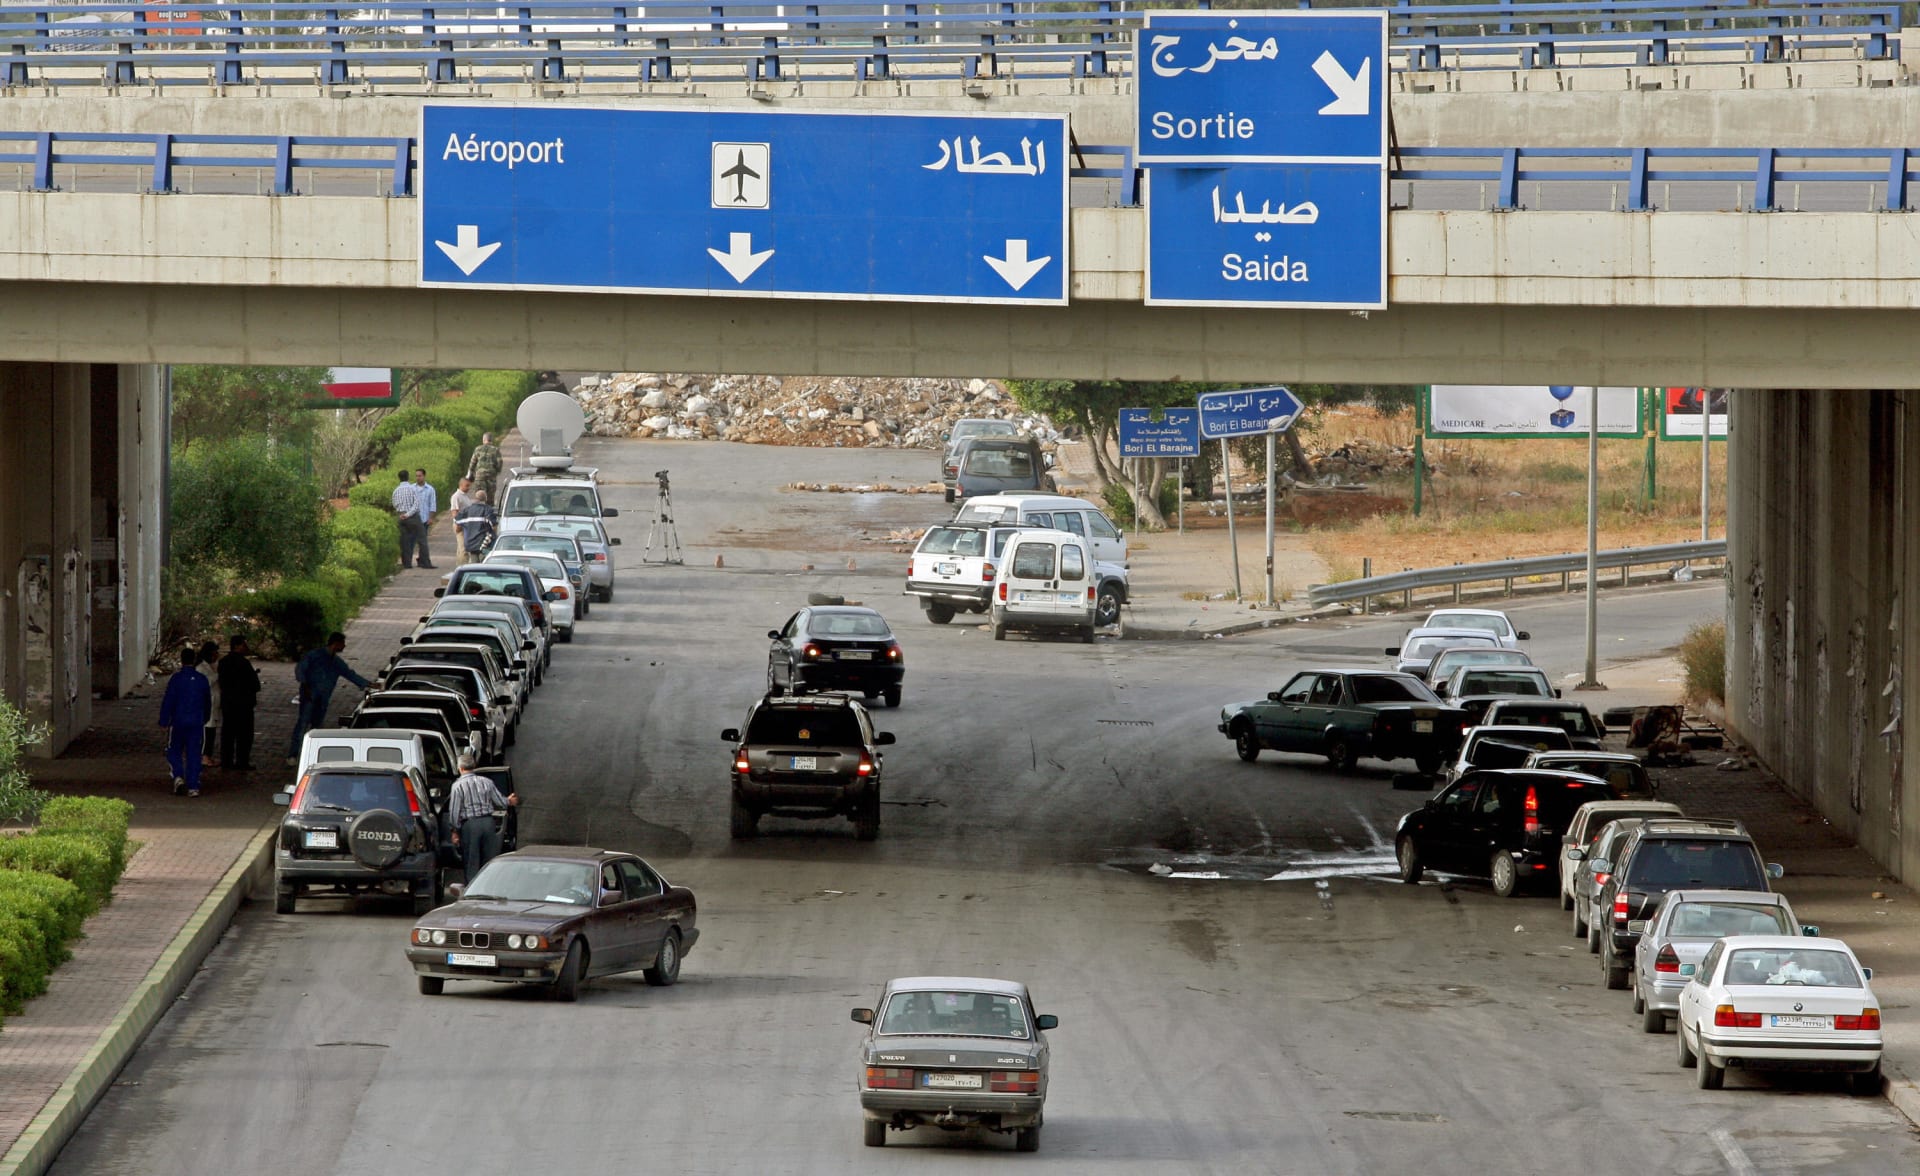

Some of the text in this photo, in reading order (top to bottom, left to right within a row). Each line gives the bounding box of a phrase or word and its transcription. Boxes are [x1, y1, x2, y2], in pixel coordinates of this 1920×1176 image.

[1150, 19, 1279, 77] مخرج
[1151, 111, 1255, 139] Sortie
[442, 132, 565, 170] Aéroport
[920, 135, 1046, 177] المطار
[1211, 185, 1319, 243] صيدا
[1221, 253, 1309, 282] Saida
[1203, 394, 1280, 412] برج البراجنة
[1168, 415, 1190, 425] برج
[1209, 422, 1228, 432] Borj
[1241, 417, 1269, 429] Barajn
[1440, 419, 1486, 428] MEDICARE
[1124, 444, 1143, 453] Borj
[1160, 444, 1194, 453] Barajne
[357, 830, 401, 842] HONDA
